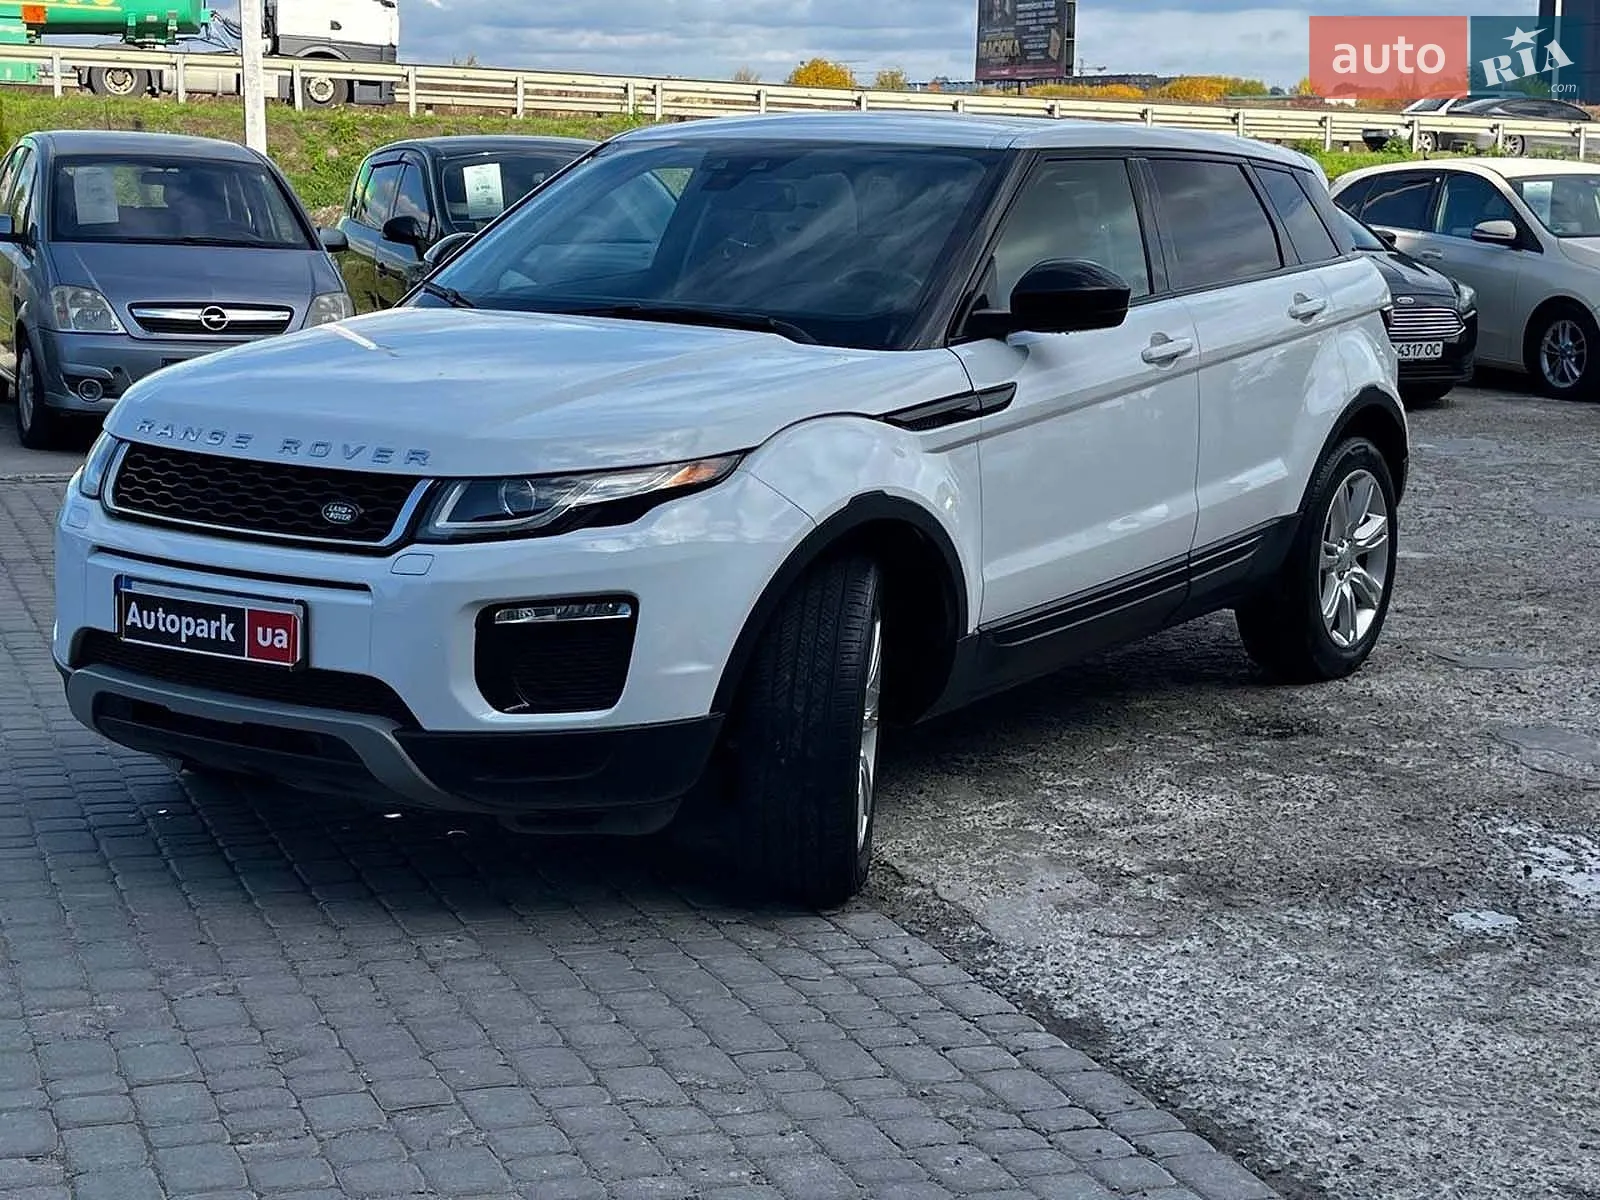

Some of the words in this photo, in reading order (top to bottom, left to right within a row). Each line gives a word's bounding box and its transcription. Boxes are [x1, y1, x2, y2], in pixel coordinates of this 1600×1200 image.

[1397, 343, 1423, 357] 4317
[1425, 343, 1440, 356] OC
[136, 418, 254, 450] RANGE
[278, 437, 433, 467] ROVER
[125, 601, 236, 643] Autopark
[257, 626, 288, 649] ua
